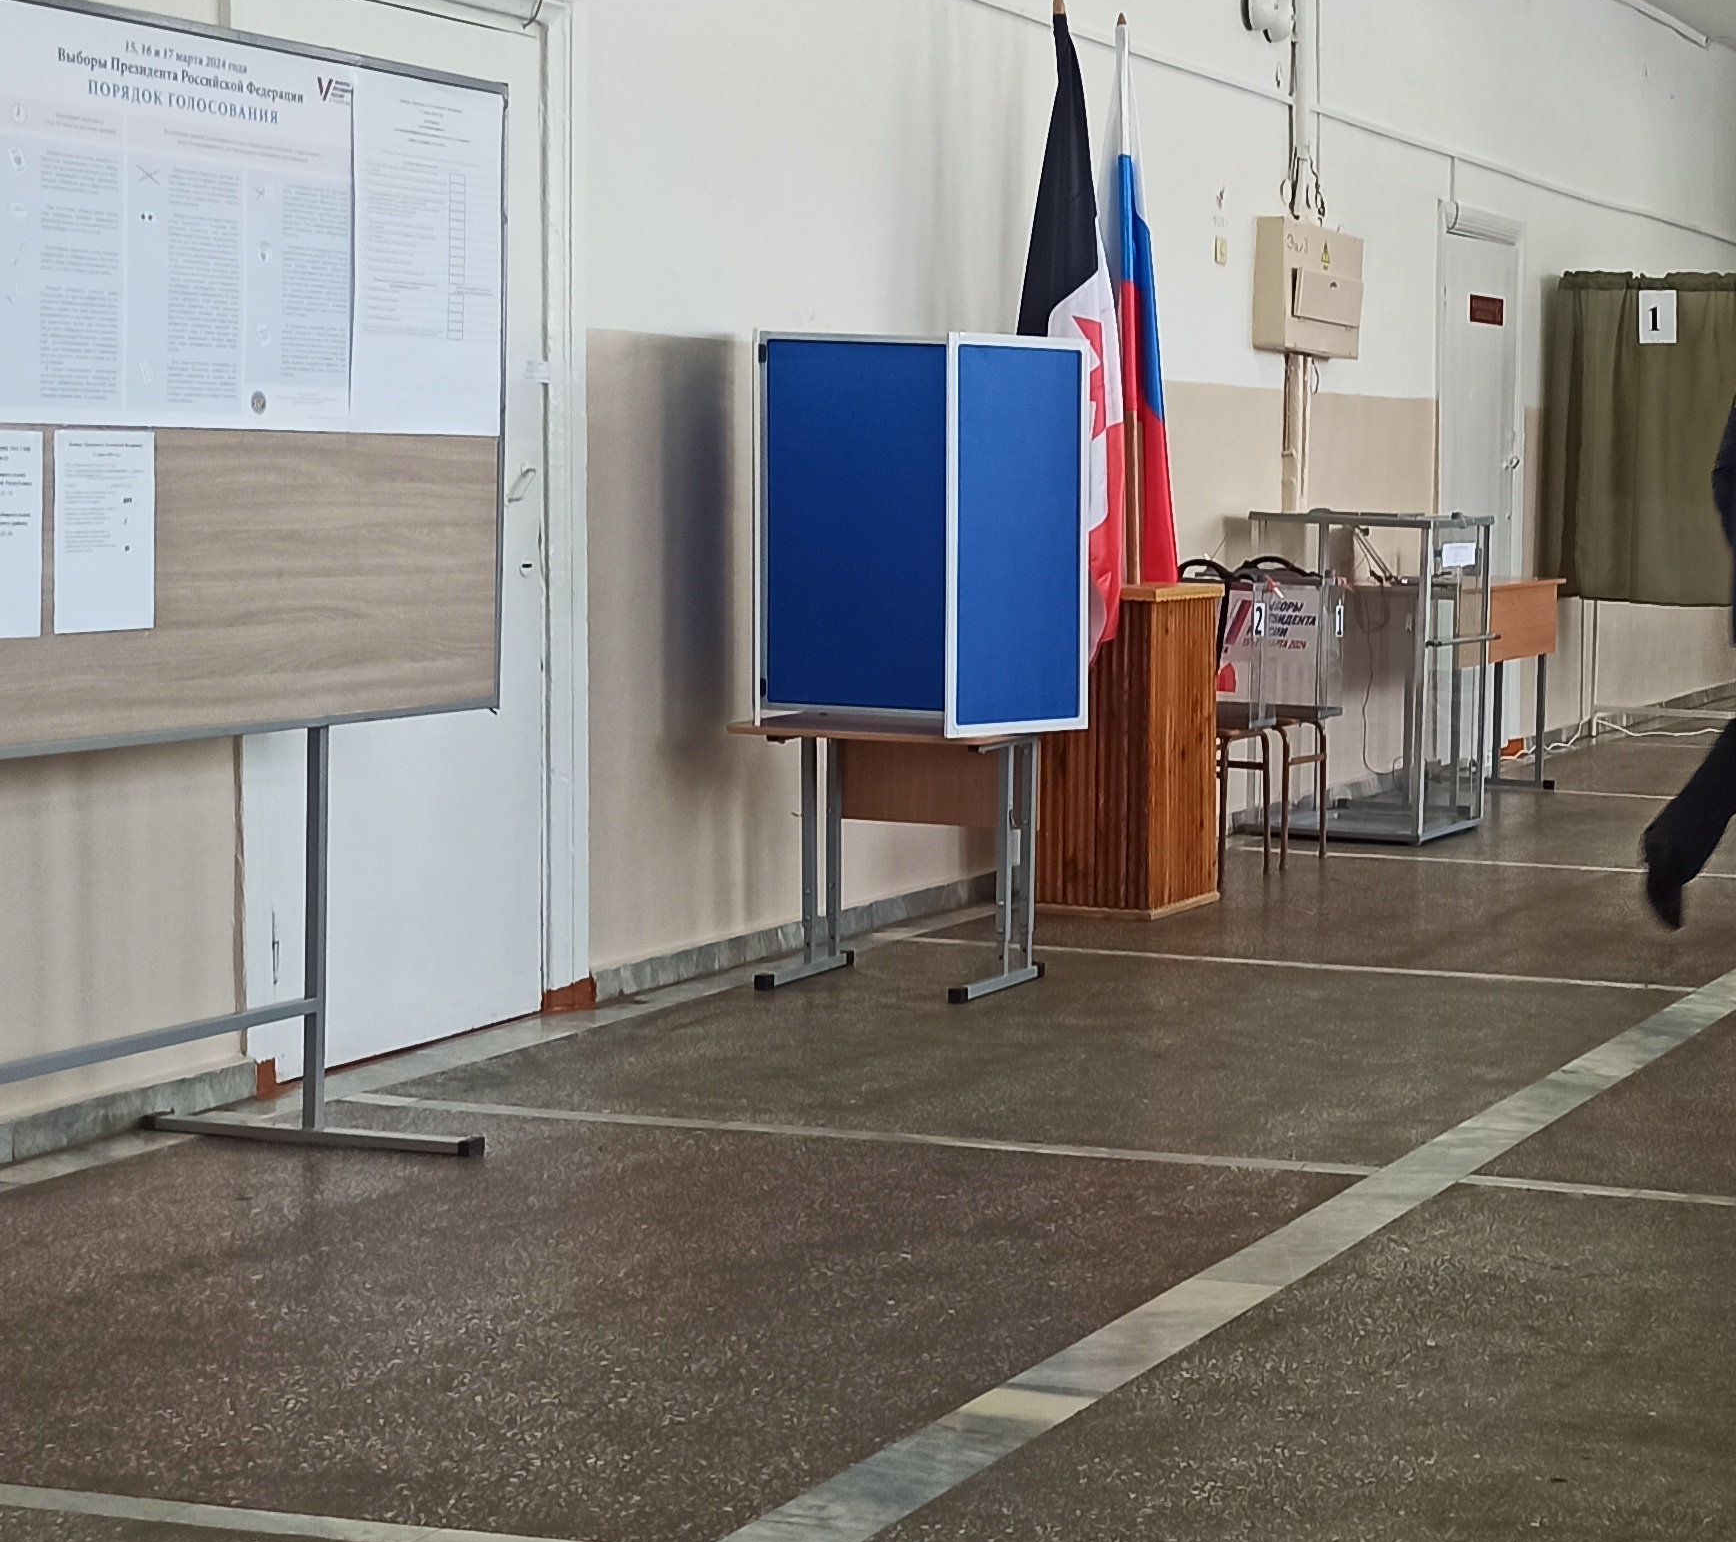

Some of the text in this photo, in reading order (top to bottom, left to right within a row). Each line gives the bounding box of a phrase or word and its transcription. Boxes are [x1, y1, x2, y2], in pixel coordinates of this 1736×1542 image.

[141, 43, 152, 57] 16
[163, 48, 174, 59] 17
[176, 52, 203, 67] марта
[205, 56, 226, 70] 2024
[228, 62, 248, 74] года
[57, 47, 304, 103] Выборы Президента Российской Федерации
[88, 79, 278, 124] ПОРЯДОК ГОЛОСОВАНИЯ
[1648, 306, 1660, 332] 1
[1254, 606, 1263, 636] 2
